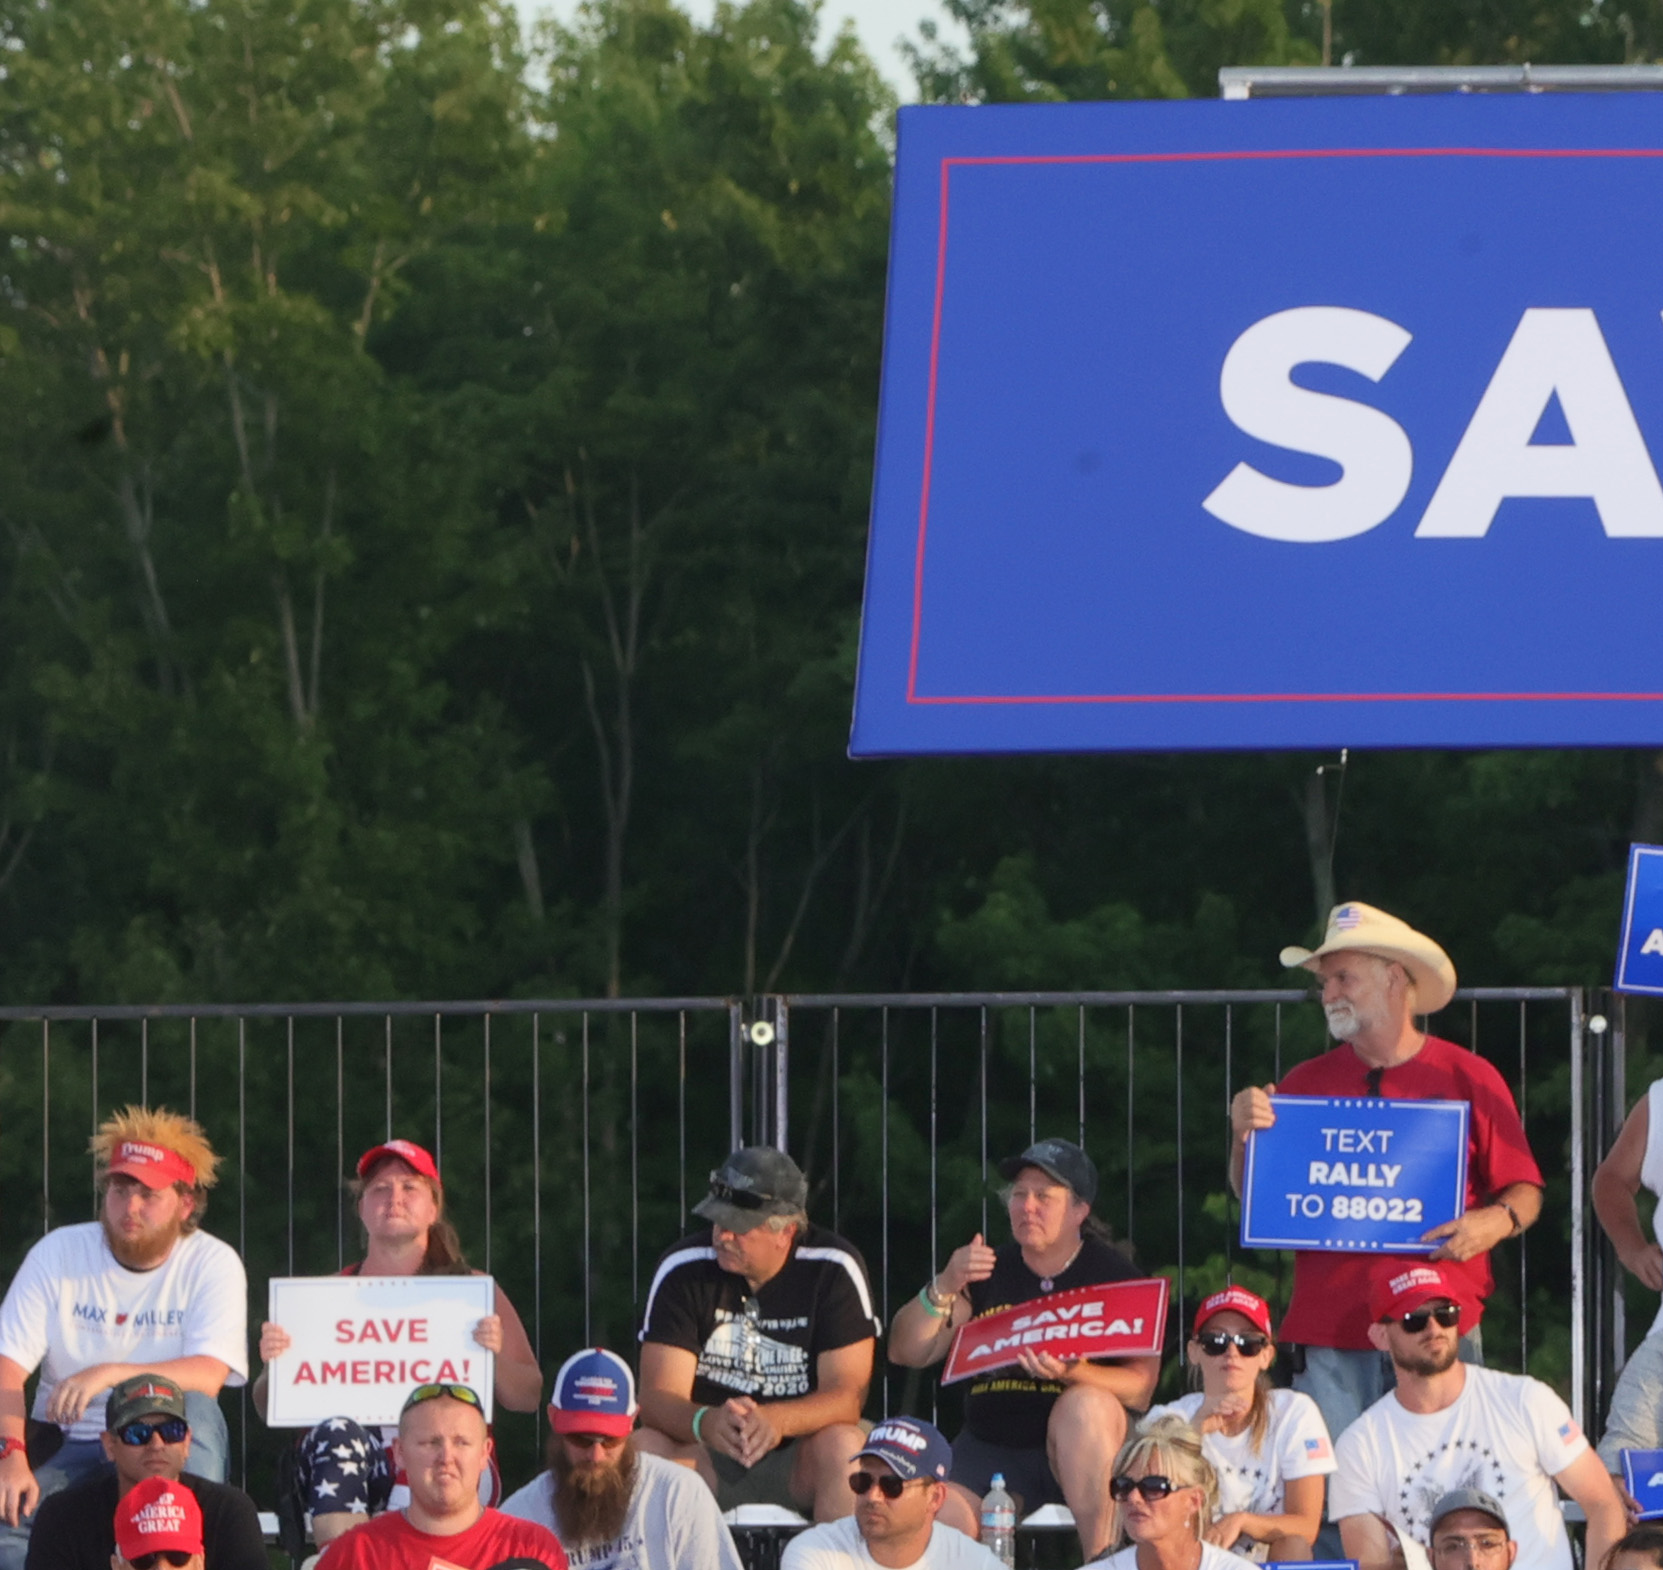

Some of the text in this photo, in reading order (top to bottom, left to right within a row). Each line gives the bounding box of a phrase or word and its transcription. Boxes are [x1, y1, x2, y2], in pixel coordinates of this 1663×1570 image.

[1321, 1129, 1393, 1155] TEXT
[1308, 1162, 1402, 1188] RALLY
[1286, 1194, 1423, 1223] TO 88022
[72, 1303, 107, 1323] MAX
[1011, 1303, 1105, 1331] SAVE
[335, 1318, 428, 1343] SAVE
[966, 1316, 1144, 1361] AMERICA!
[294, 1357, 471, 1386] AMERICA!
[871, 1426, 927, 1451] TRUMP
[139, 1520, 181, 1535] GREAT
